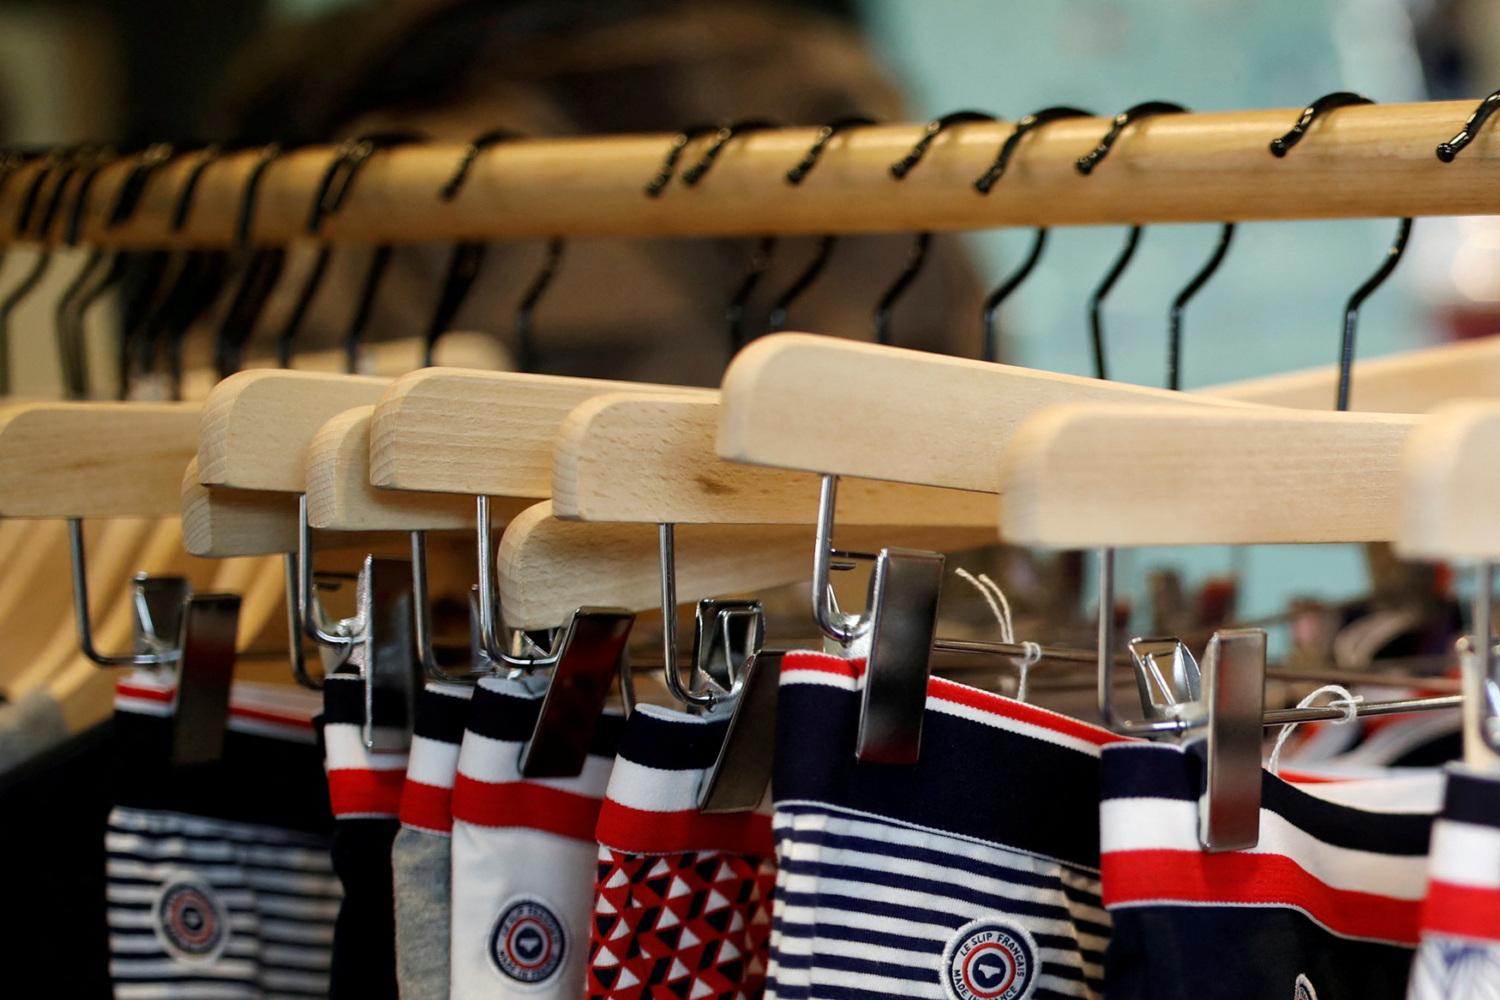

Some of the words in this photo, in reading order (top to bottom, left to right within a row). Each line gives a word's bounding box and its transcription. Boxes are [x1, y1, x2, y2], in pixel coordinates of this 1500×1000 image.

[960, 943, 971, 957] LE
[971, 932, 993, 946] SLIP
[953, 969, 969, 996] MADE
